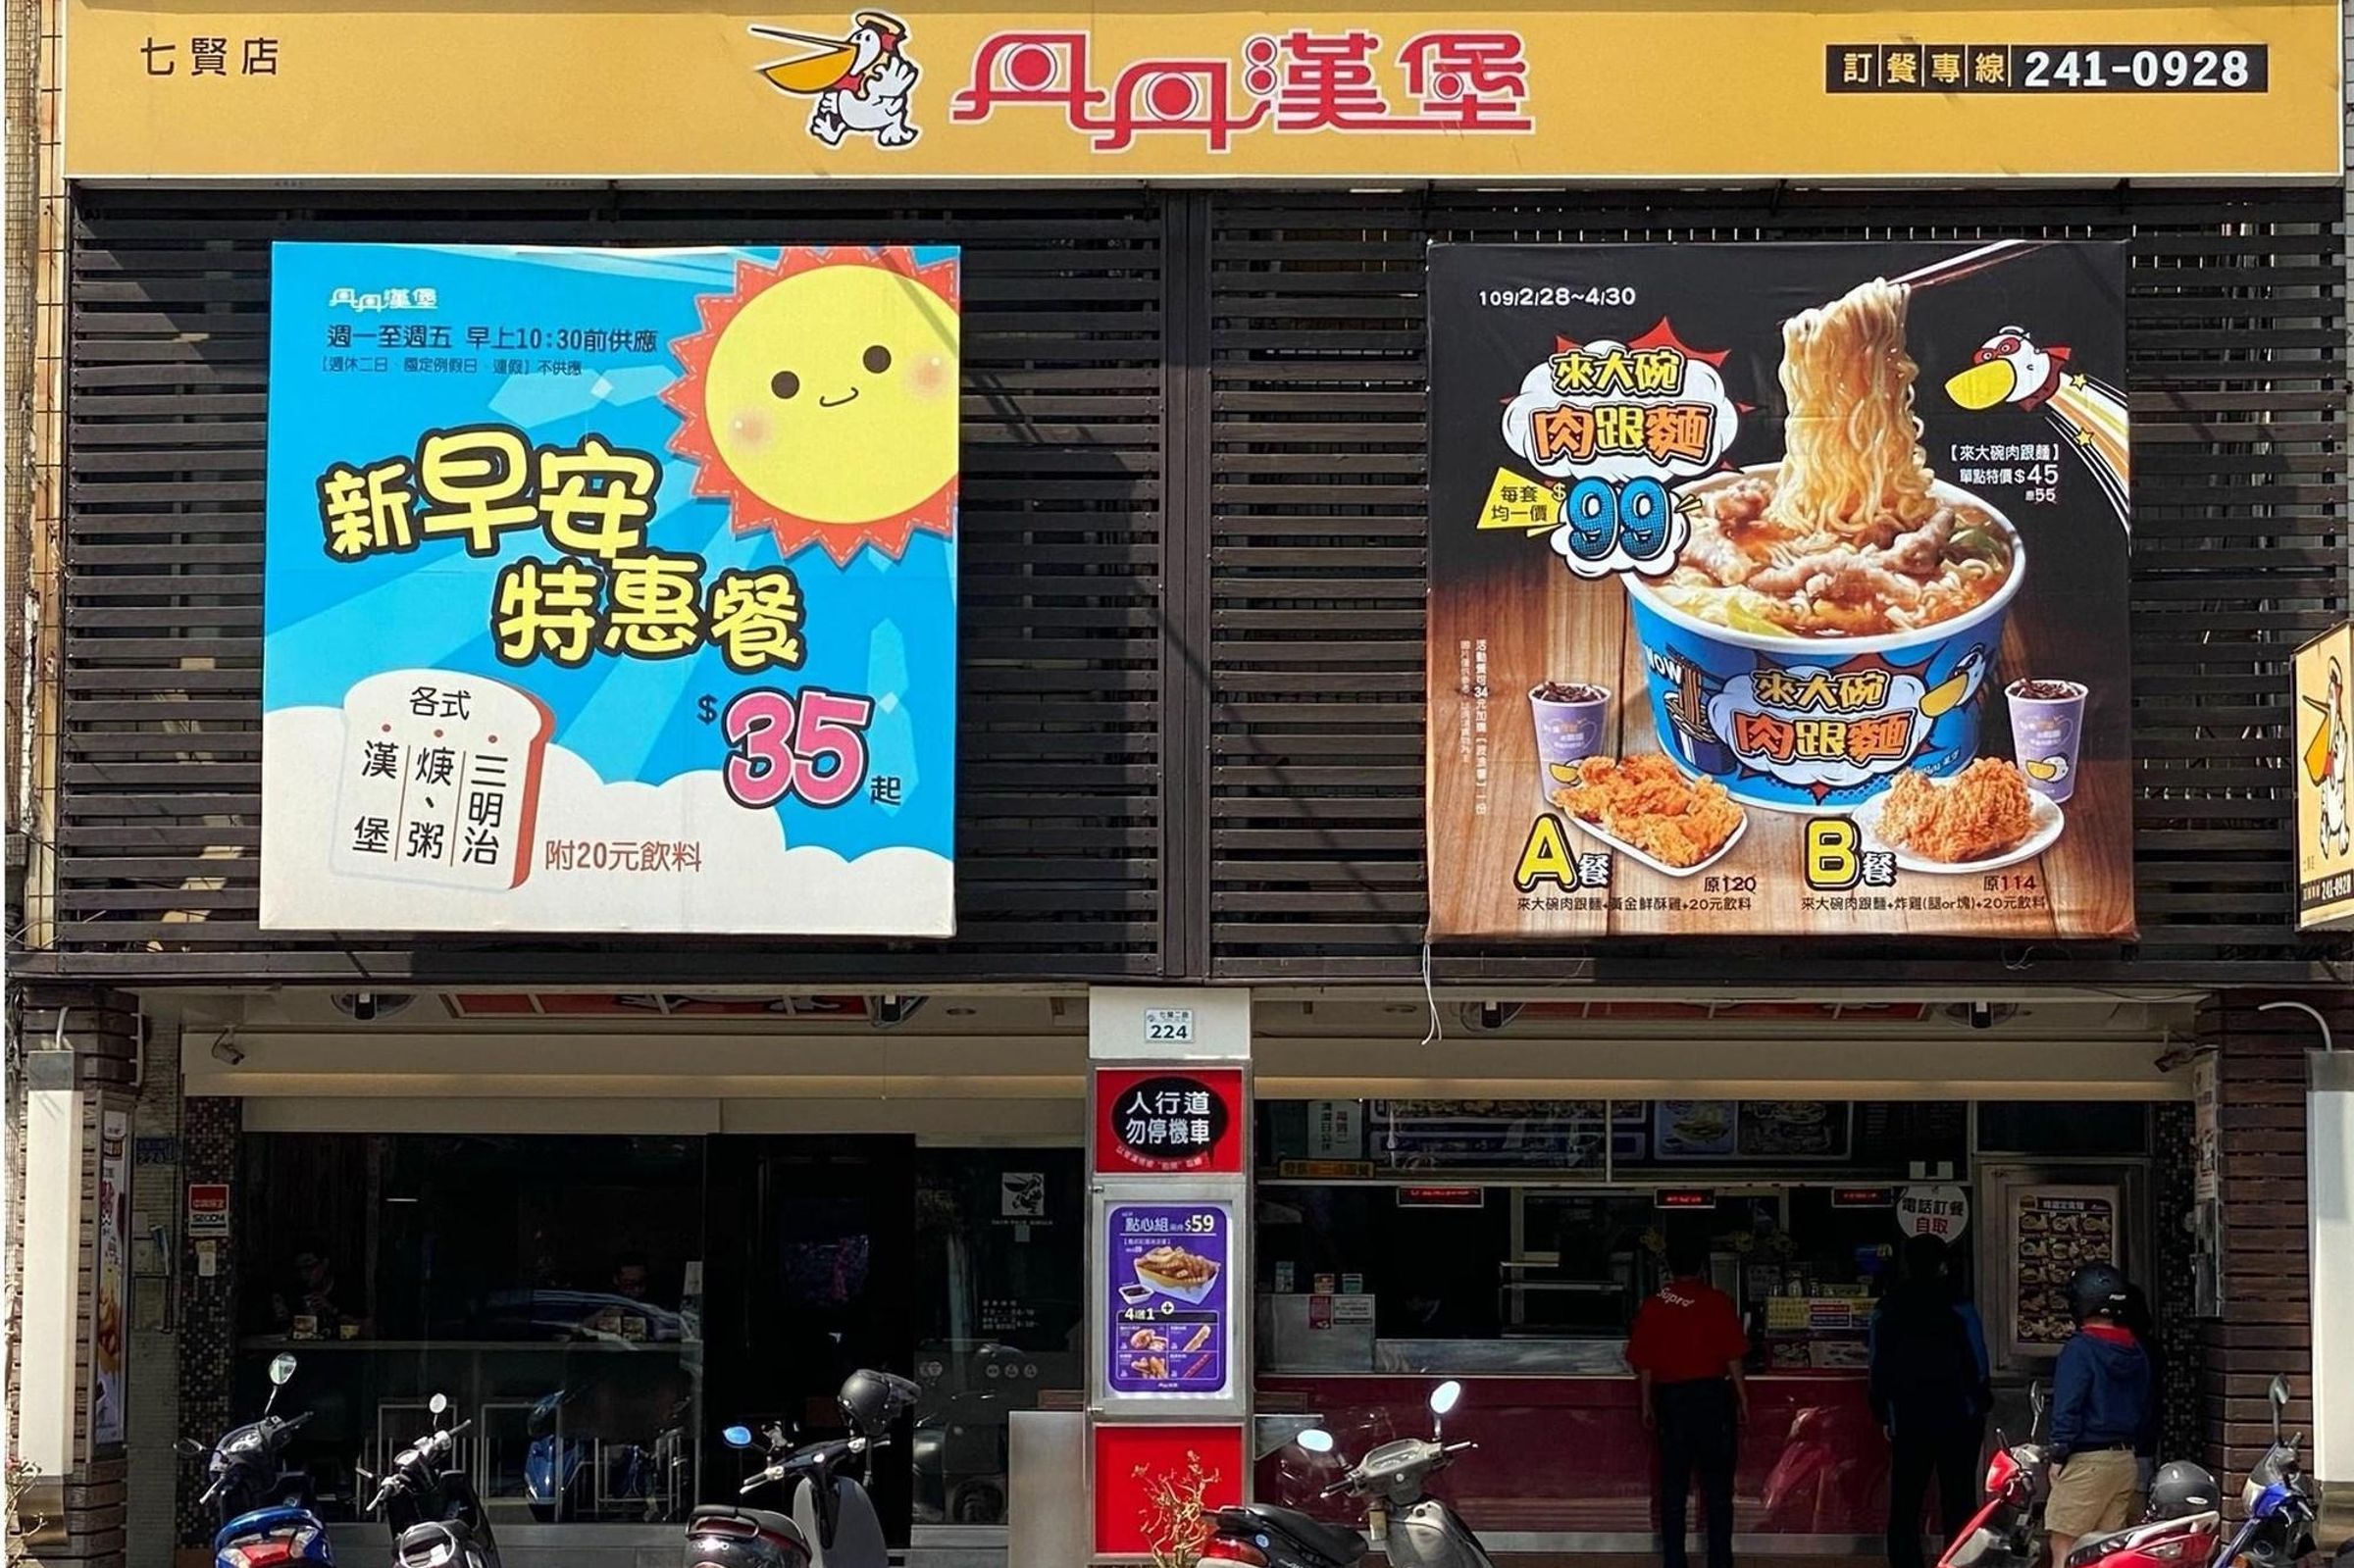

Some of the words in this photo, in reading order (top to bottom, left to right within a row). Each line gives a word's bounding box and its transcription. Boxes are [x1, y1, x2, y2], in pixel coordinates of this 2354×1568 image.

[140, 37, 280, 76] 七賢店
[1843, 52, 2006, 84] 訂餐專線
[2024, 50, 2249, 88] 241-0928
[951, 30, 1534, 151] 丹丹漢堡
[1478, 286, 1636, 306] 109/2/28~4/30
[327, 324, 452, 350] 週一至週五
[466, 327, 658, 353] 早上10:30前供應
[1550, 348, 1687, 396] 來大碗
[1531, 403, 1717, 466] 肉跟麵
[320, 430, 658, 557] 新早安
[1501, 485, 1538, 503] 每套
[1491, 505, 1548, 523] 均一價
[492, 558, 806, 671] 特惠餐
[409, 687, 471, 722] 各式
[1752, 670, 1889, 712] 來大碗
[1731, 709, 1918, 765] 肉跟麵
[462, 752, 508, 867] 三明治
[545, 838, 703, 874] 附20元飲料
[1150, 1024, 1188, 1039] 224
[1126, 1090, 1210, 1116] 人行道
[1125, 1117, 1210, 1145] 勿停機車
[1184, 1214, 1214, 1233] $59
[1902, 1196, 1965, 1217] 電話訂餐
[1917, 1217, 1949, 1235] 自取
